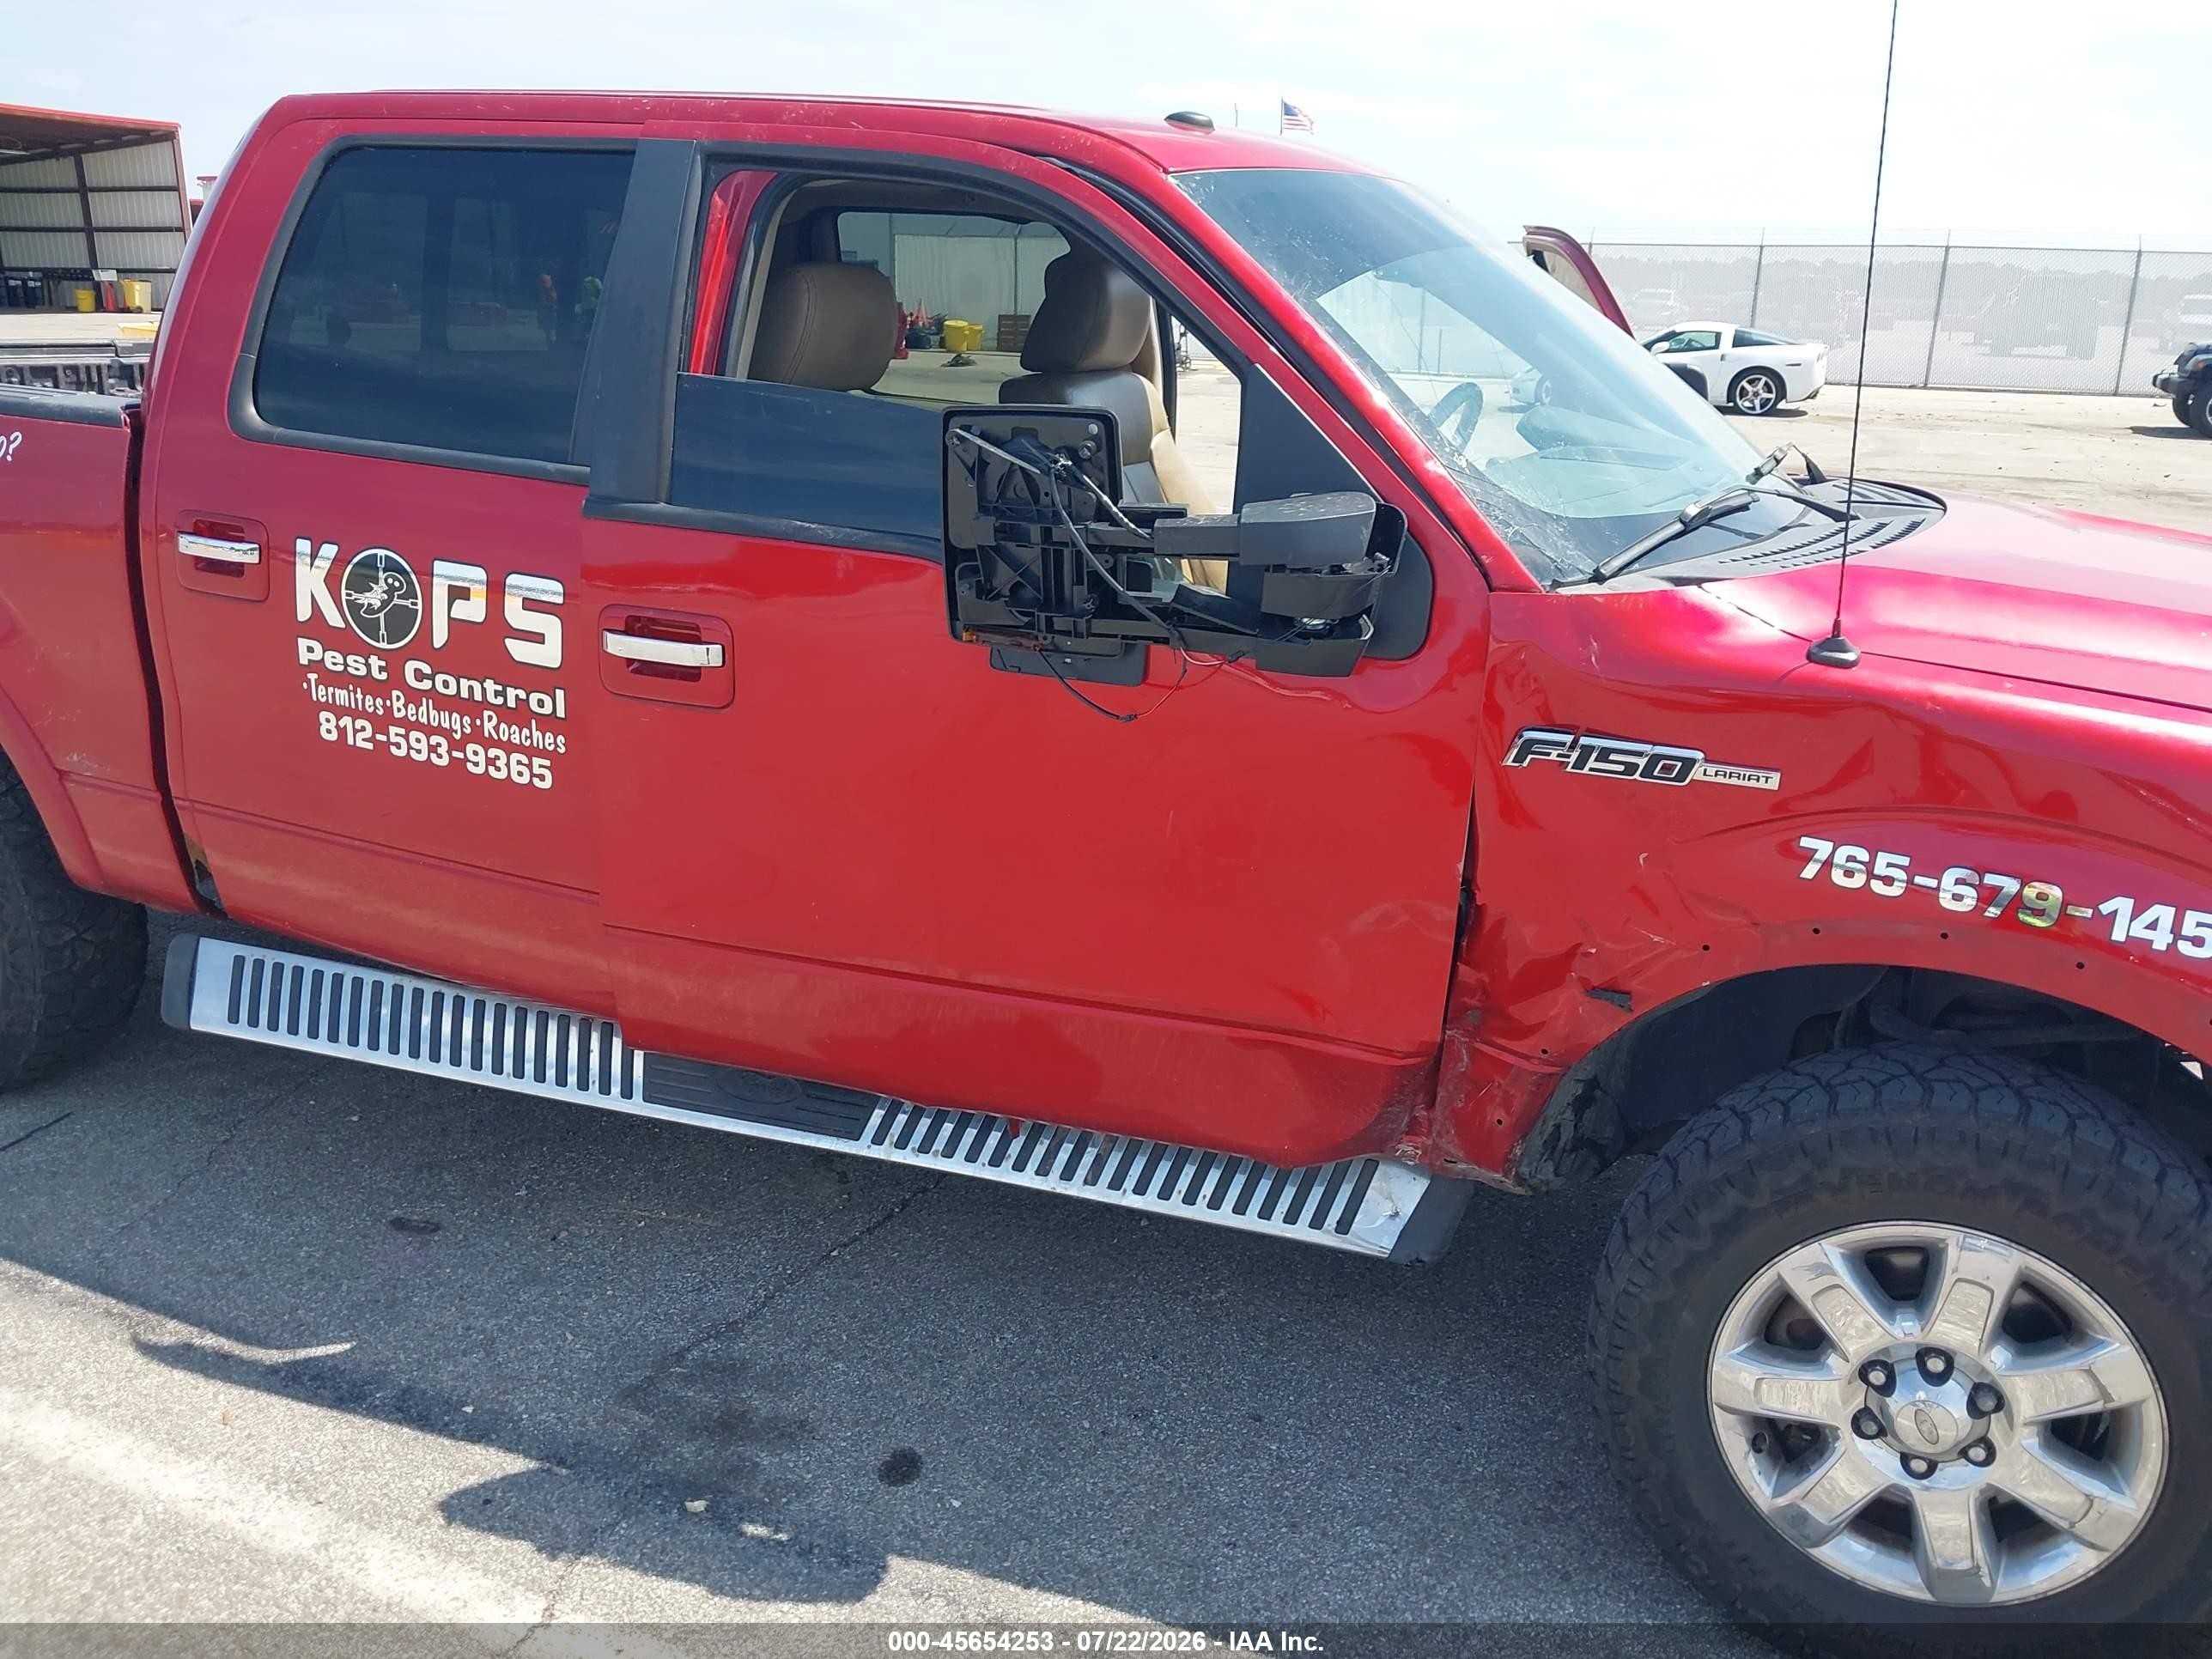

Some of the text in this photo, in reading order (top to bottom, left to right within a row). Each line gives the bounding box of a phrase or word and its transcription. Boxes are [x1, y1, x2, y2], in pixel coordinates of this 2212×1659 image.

[297, 636, 566, 720] Pest Control
[319, 711, 553, 790] 812-593-9365
[1502, 726, 1774, 786] F-150 LARIAT
[1797, 836, 2212, 959] 765-679-145
